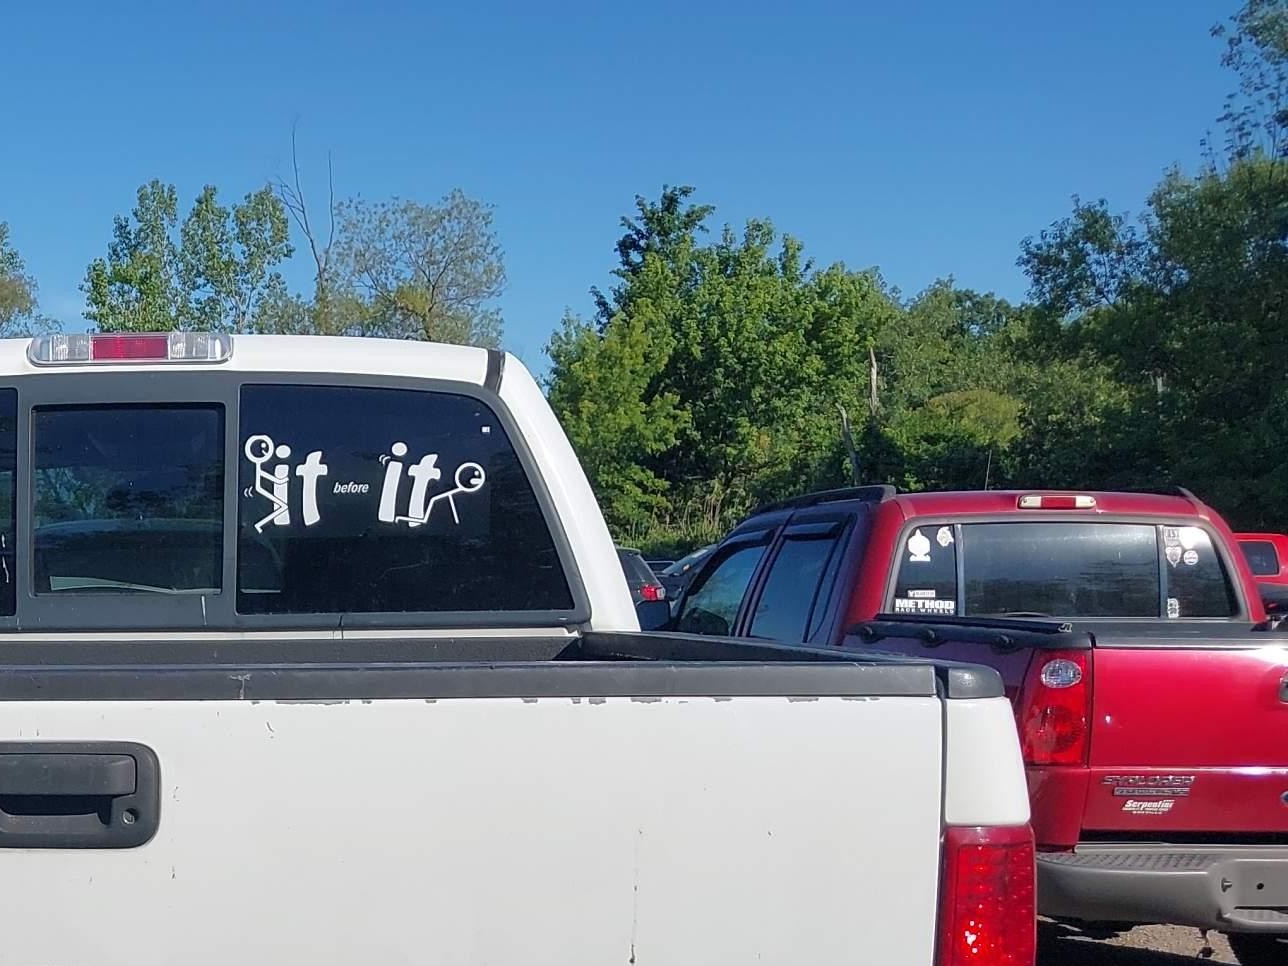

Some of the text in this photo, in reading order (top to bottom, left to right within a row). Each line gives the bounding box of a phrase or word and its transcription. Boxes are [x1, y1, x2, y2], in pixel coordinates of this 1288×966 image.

[273, 442, 441, 527] it before it
[895, 598, 955, 609] METHOD
